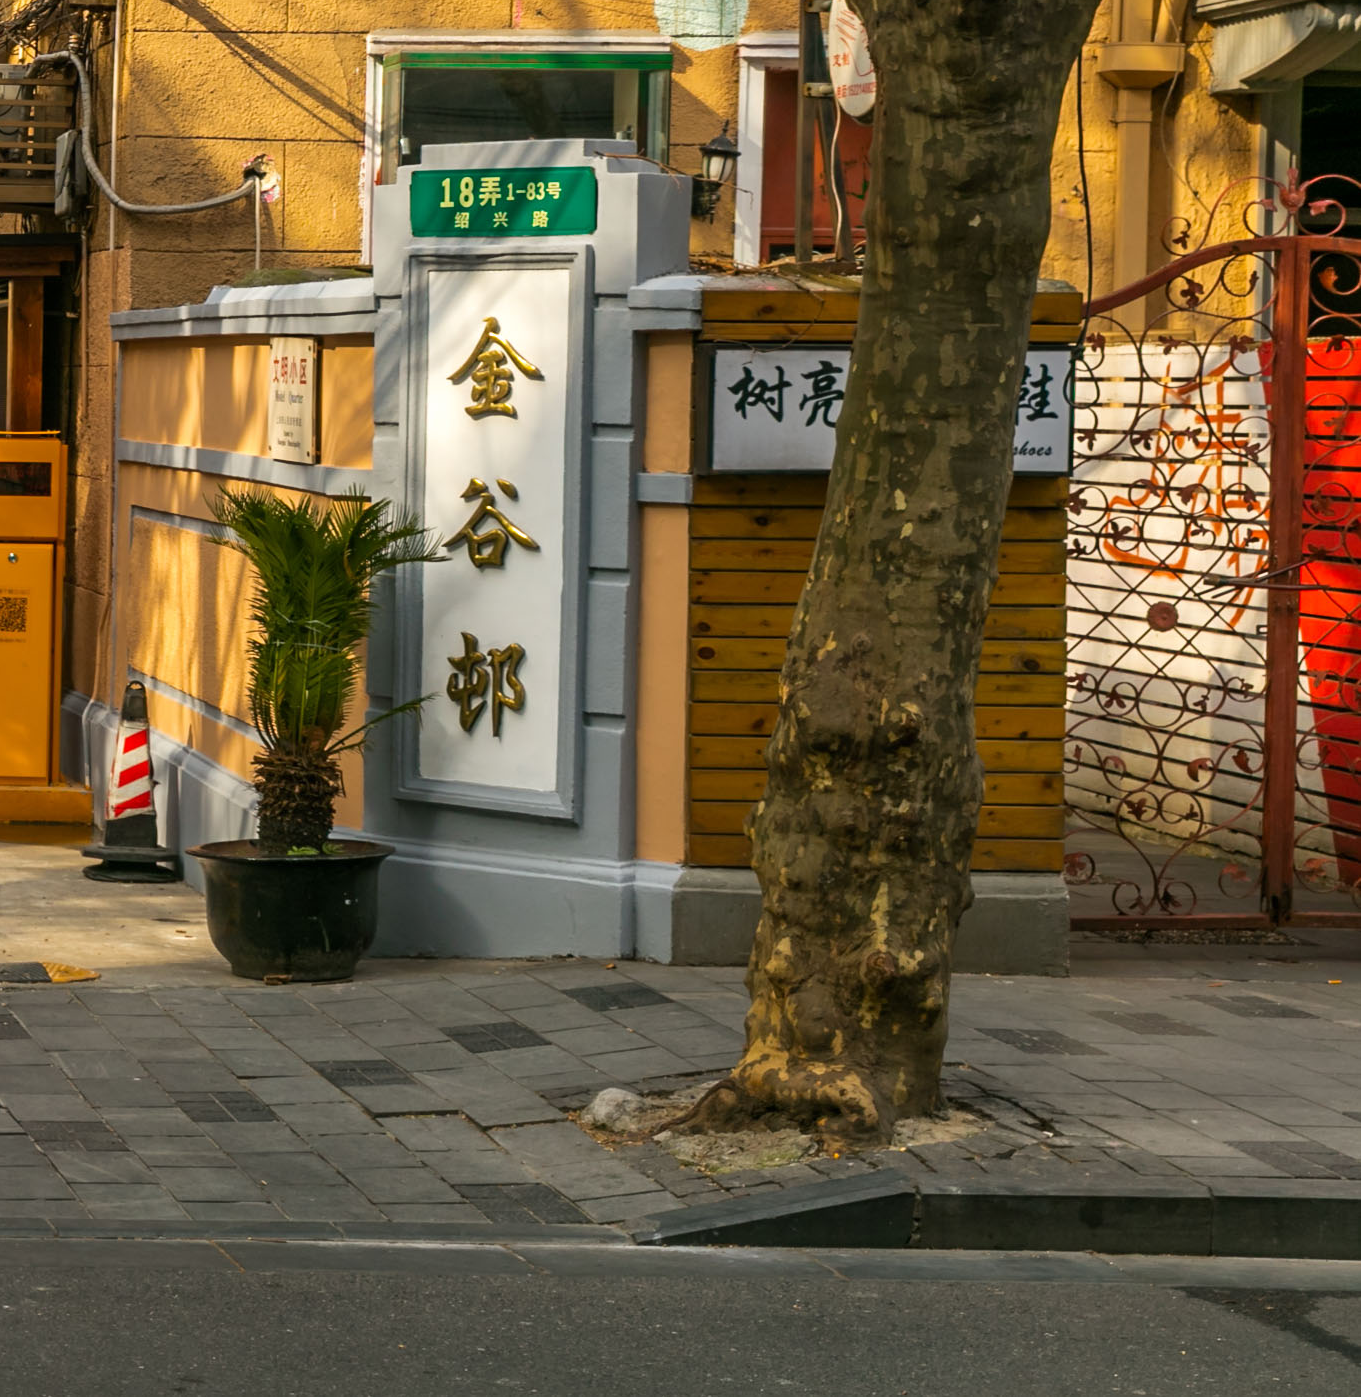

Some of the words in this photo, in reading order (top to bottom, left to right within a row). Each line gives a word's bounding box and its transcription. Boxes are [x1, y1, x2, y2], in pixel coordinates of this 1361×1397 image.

[454, 210, 549, 229] 绍兴路
[273, 355, 307, 385] 文明小区
[441, 315, 546, 738] 金谷邨
